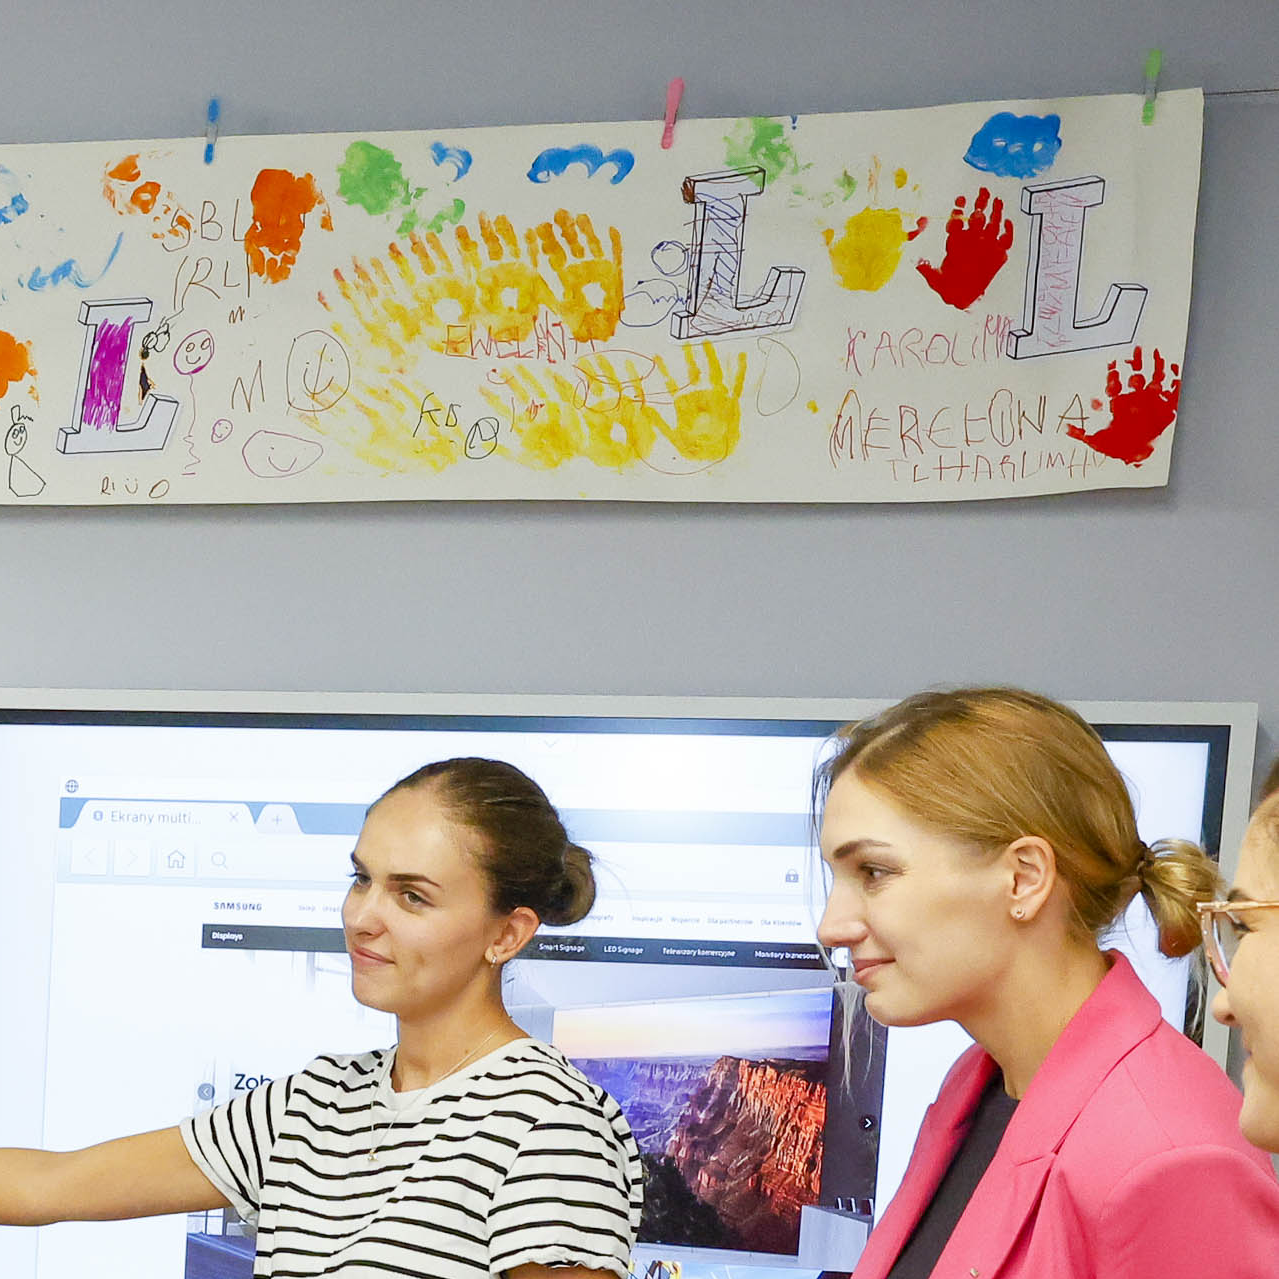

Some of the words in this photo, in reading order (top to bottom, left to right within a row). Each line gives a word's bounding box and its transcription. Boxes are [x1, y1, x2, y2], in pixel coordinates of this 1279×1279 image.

[110, 810, 155, 825] Ekrany
[213, 901, 263, 912] SAMSUNG
[211, 931, 243, 942] Displays
[539, 943, 558, 951] Smart
[559, 944, 585, 953] Signage
[603, 945, 617, 953] LED
[617, 946, 644, 955] Signage
[754, 950, 784, 960] Monitory
